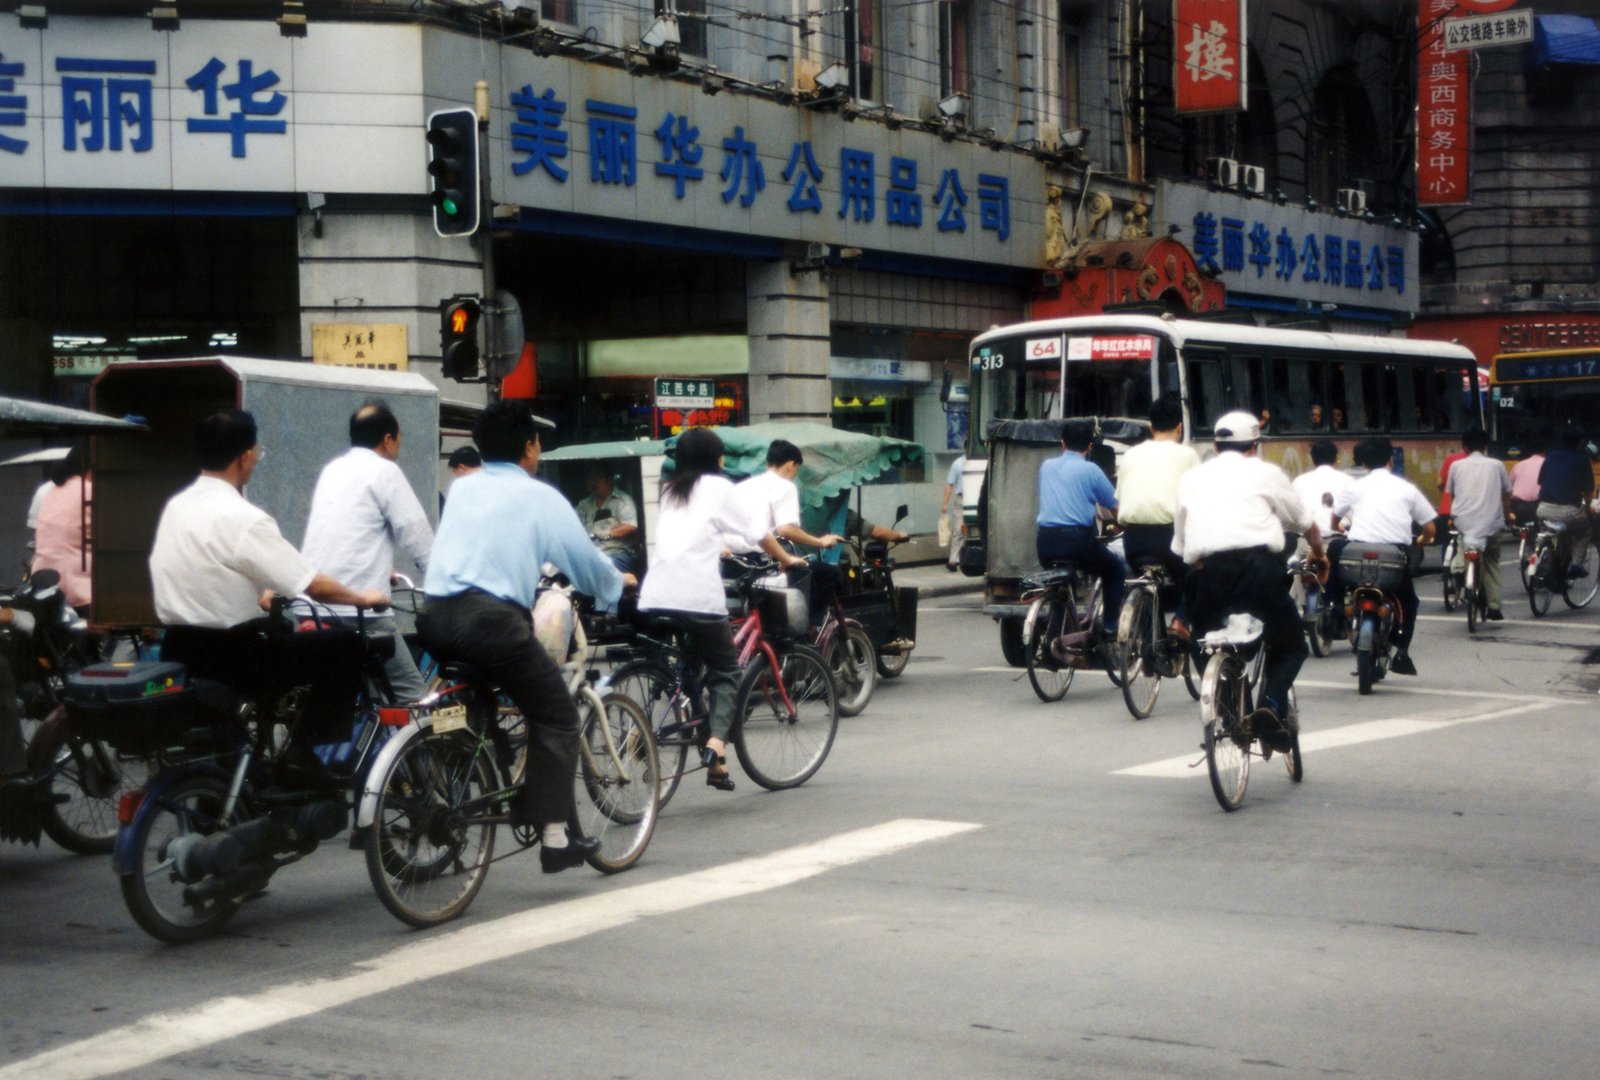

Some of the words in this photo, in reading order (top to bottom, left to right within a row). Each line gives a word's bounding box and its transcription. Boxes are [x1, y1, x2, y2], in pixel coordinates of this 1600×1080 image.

[1448, 16, 1528, 44] 公交线路车除外
[511, 83, 1010, 241] 美丽华办公用品公司
[1193, 210, 1405, 295] 美丽华办公用品公司
[1032, 342, 1056, 357] 64
[981, 354, 1004, 371] 313
[1573, 360, 1596, 375] 17
[661, 382, 708, 396] 江西中路
